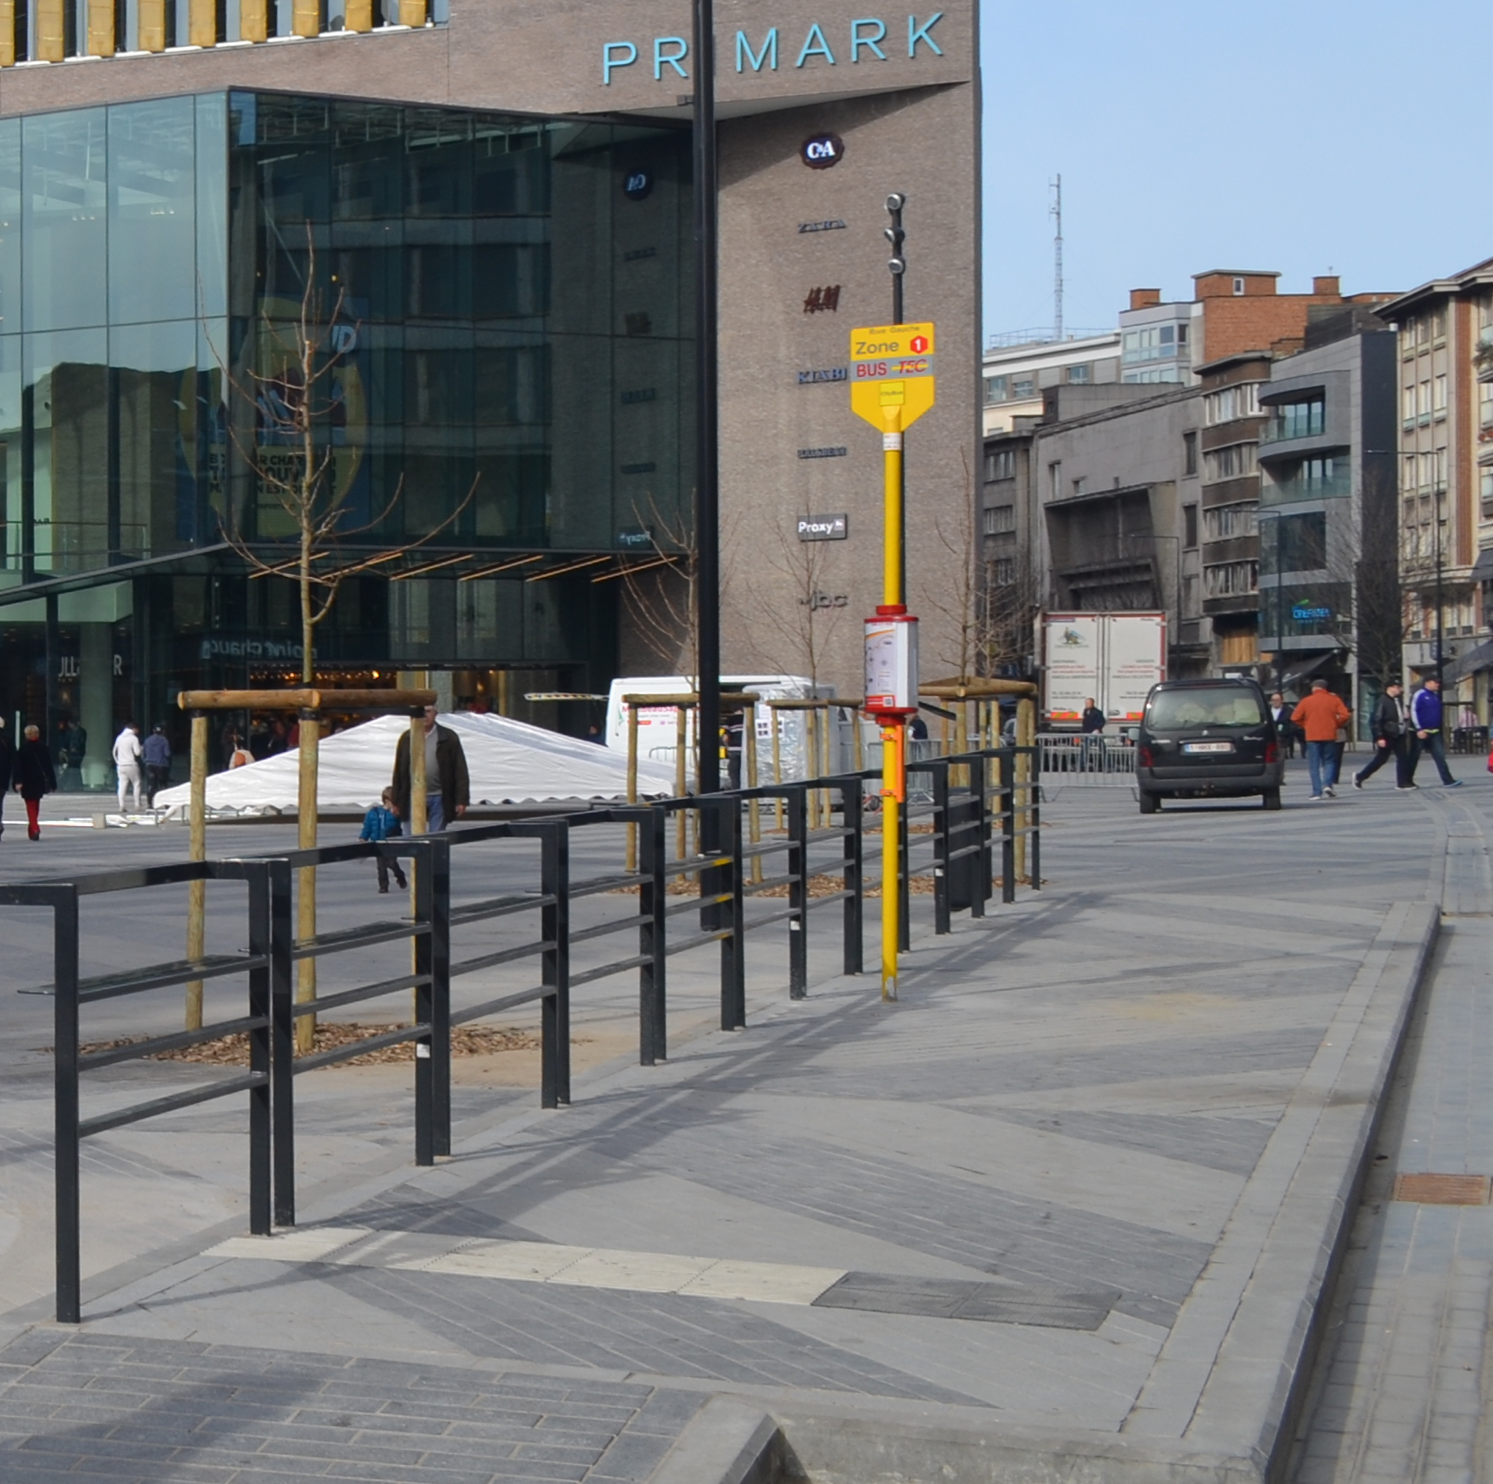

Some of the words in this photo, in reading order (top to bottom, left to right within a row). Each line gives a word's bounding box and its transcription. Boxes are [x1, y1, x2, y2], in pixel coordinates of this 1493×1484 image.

[602, 11, 944, 85] PRMARK
[890, 324, 920, 334] Gauche
[855, 341, 900, 356] Zone
[856, 362, 888, 378] BUS
[898, 359, 927, 375] TEC
[798, 521, 834, 535] Proxy
